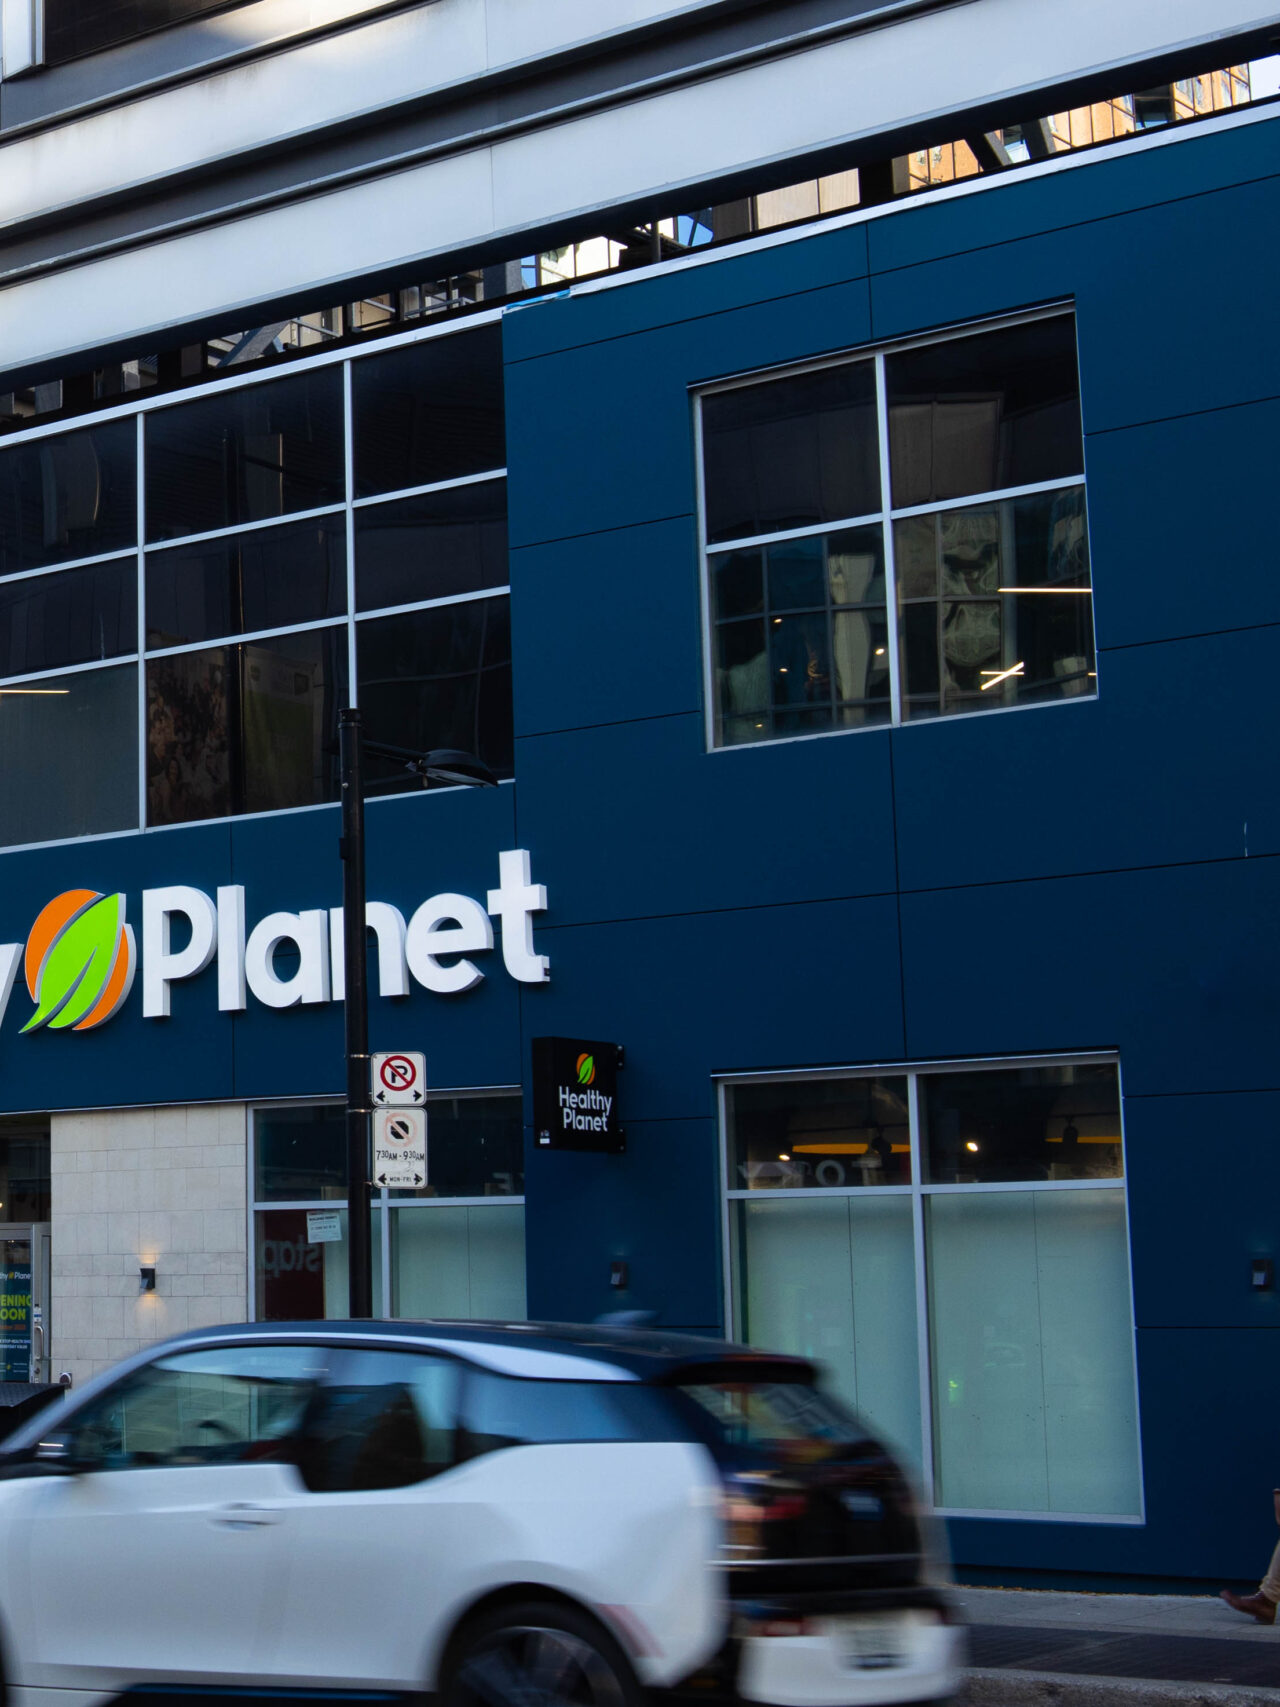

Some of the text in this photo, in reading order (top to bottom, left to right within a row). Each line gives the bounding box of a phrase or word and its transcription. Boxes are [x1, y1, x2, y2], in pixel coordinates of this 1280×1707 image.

[142, 848, 550, 1017] Planet
[559, 1085, 612, 1116] Healthy
[563, 1107, 608, 1132] Planet
[14, 1271, 31, 1280] Plane
